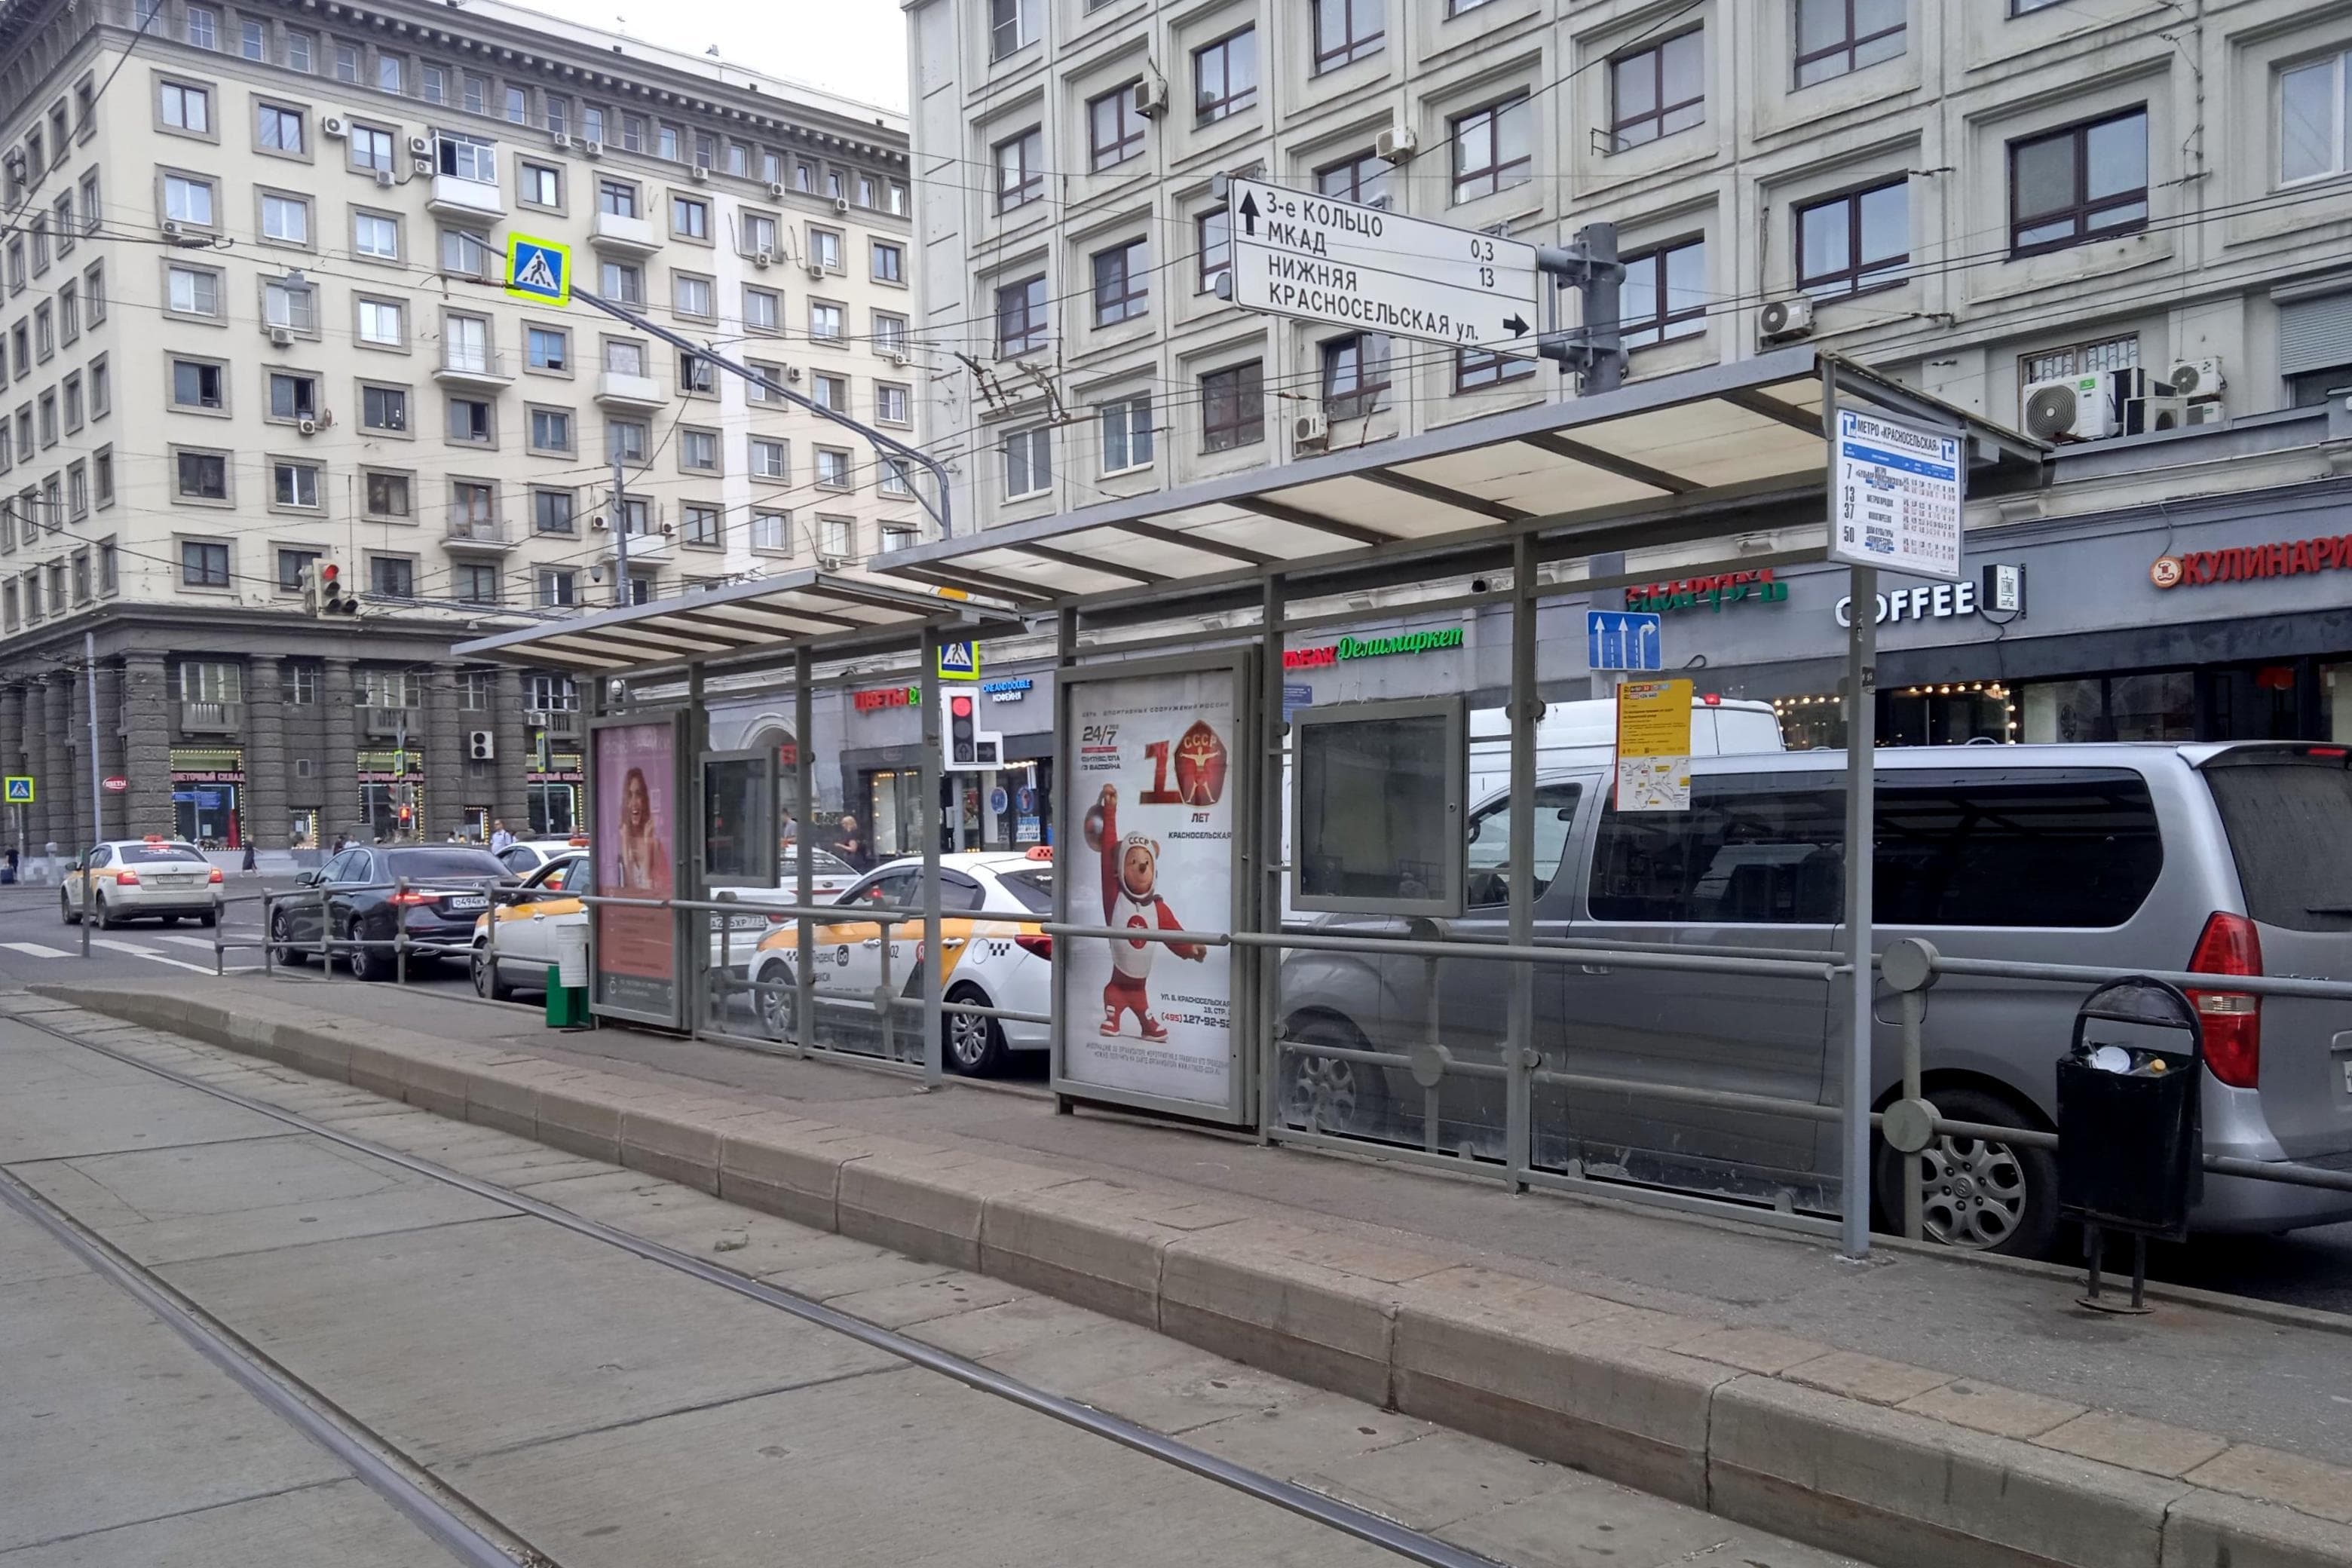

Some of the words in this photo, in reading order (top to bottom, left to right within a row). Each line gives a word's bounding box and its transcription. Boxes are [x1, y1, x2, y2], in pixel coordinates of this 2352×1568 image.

[1266, 191, 1296, 218] 3-е
[1303, 200, 1383, 237] КОЛЬЦО
[1471, 238, 1494, 264] 0,3
[1268, 221, 1328, 256] МКАД
[1478, 266, 1494, 288] 13
[1268, 254, 1358, 292] НИЖНЯЯ
[1269, 283, 1450, 335] КРАСНОСЕЛЬСКАЯ
[1456, 322, 1479, 342] ул.
[1857, 419, 1879, 437] МЕТРО
[1847, 463, 1852, 479] 7
[1844, 485, 1855, 503] 13
[1844, 503, 1854, 519] 37
[1844, 525, 1854, 543] 50
[1337, 627, 1464, 660] Делимаркет
[1083, 725, 1116, 746] 24/7
[1184, 733, 1217, 749] СССР
[1191, 813, 1210, 823] ЛЕТ
[1129, 836, 1149, 846] СССР
[1168, 831, 1232, 840] КРАСНОСЕЛЬСКАЯ
[1161, 1011, 1183, 1023] (495)
